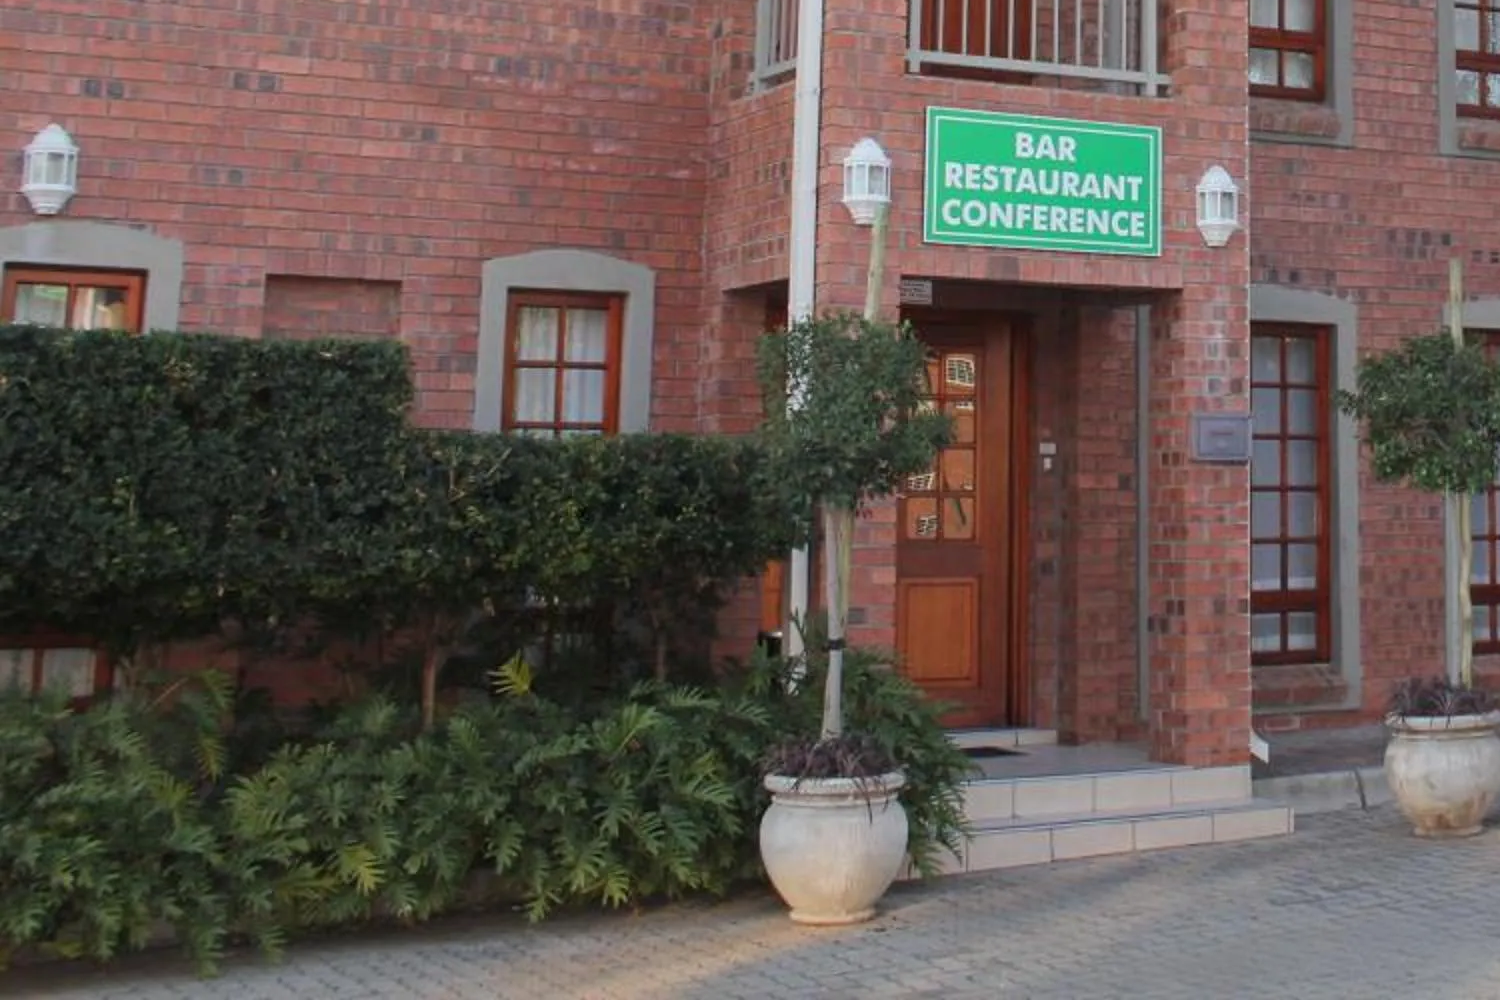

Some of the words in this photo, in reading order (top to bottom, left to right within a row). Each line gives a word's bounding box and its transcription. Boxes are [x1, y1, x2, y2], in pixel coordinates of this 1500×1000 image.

[1015, 132, 1077, 162] BAR
[944, 162, 1143, 201] RESTAURANT
[942, 199, 1145, 237] CONFERENCE
